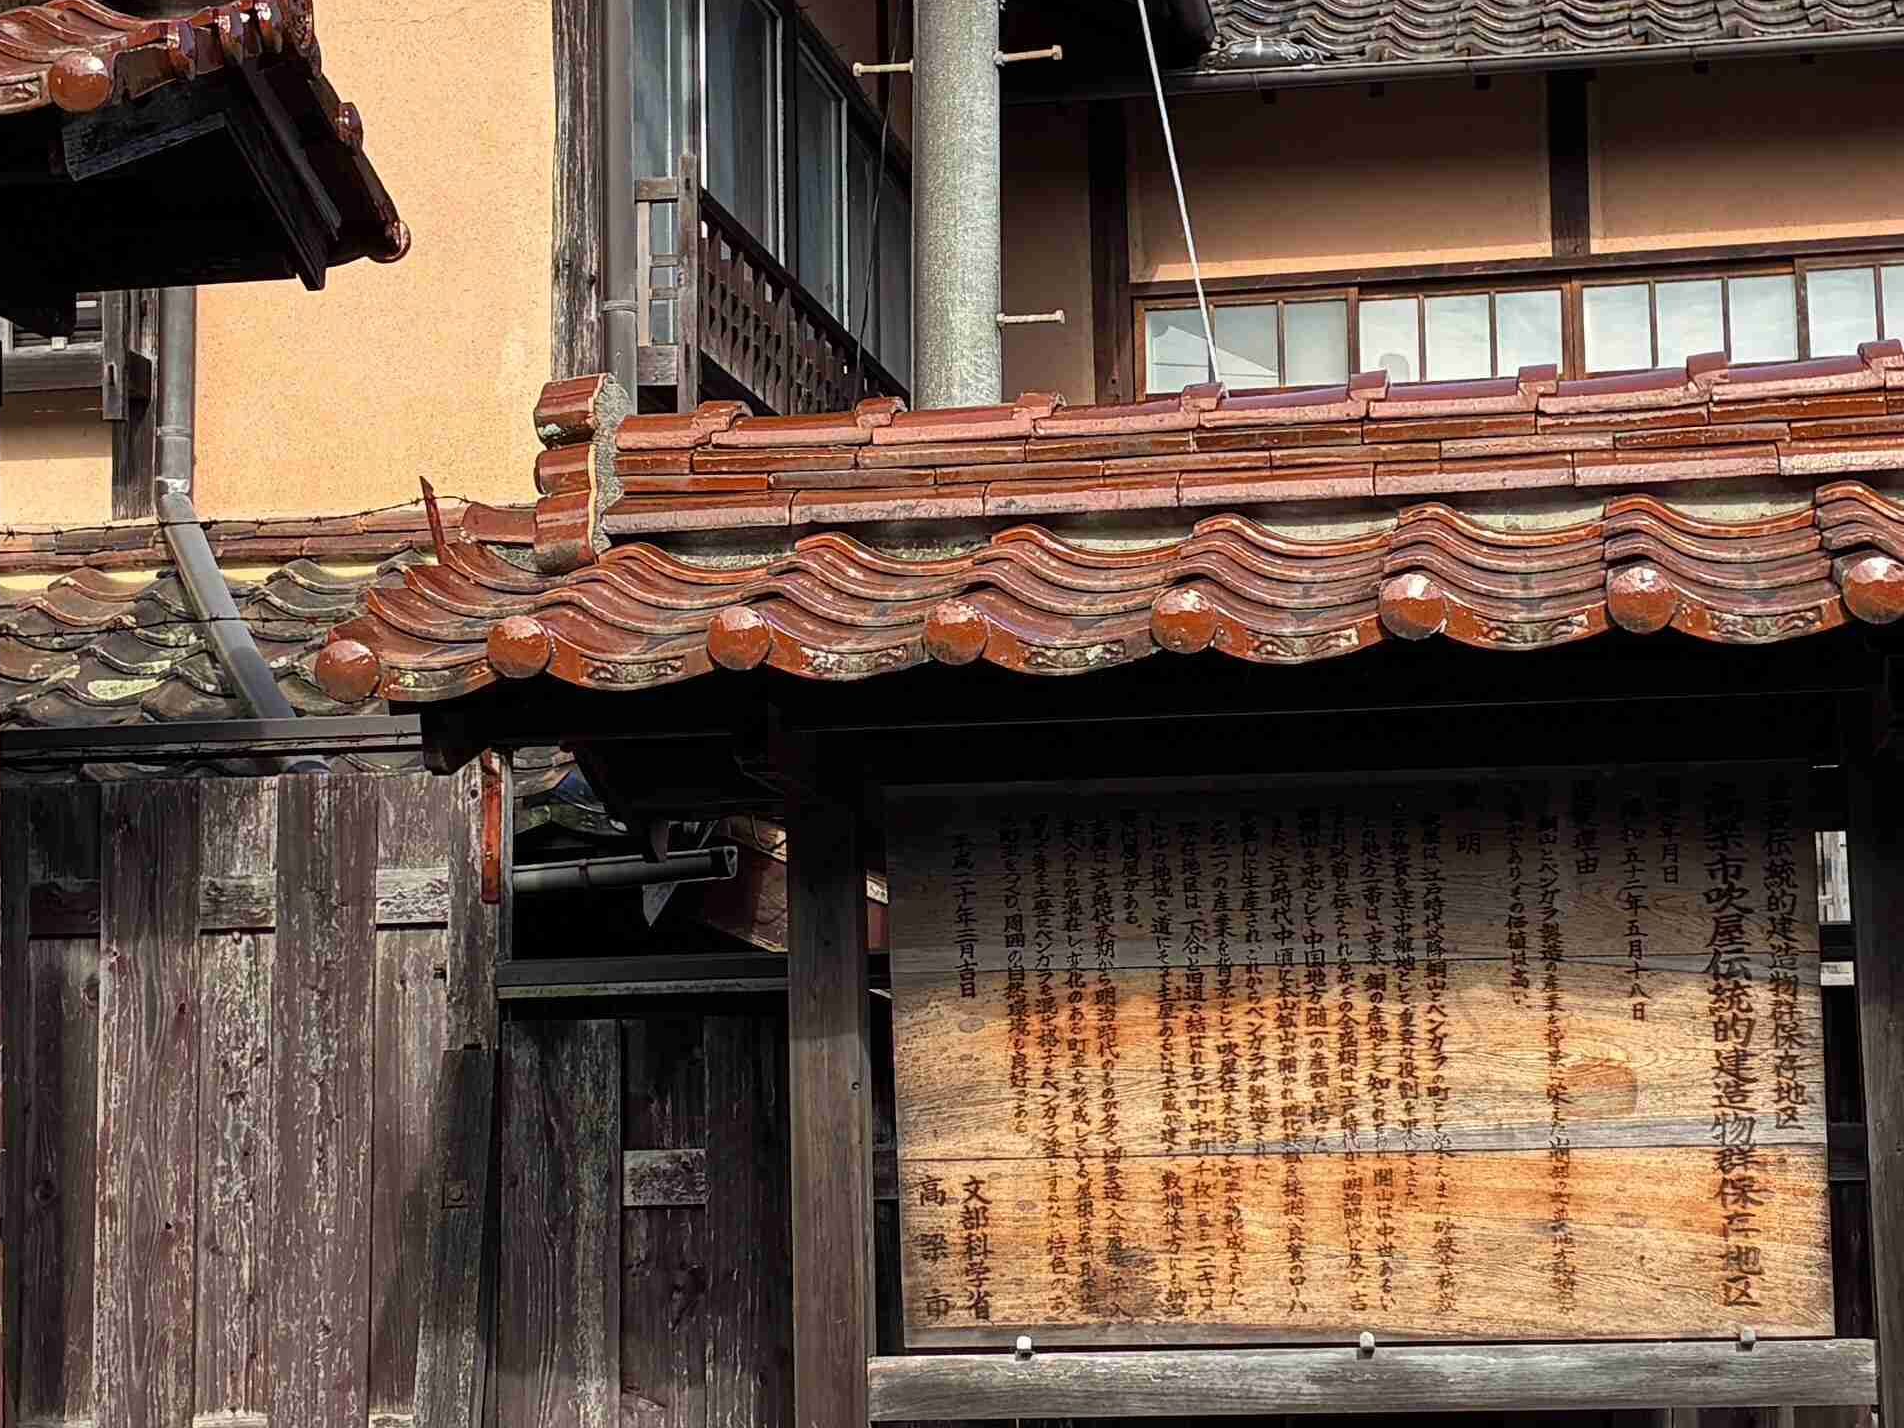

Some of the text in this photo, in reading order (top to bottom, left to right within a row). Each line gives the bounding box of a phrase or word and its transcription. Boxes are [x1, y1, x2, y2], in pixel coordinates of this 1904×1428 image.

[1616, 790, 1651, 1022] 和五十二年五月十八日
[1761, 778, 1807, 1130] 伝統的建造物群保存地区
[1703, 780, 1775, 1308] 梁市吹屋伝統的建造物群保存地区
[914, 1176, 953, 1322] 高梁市
[960, 1174, 995, 1321] 文部科学省
